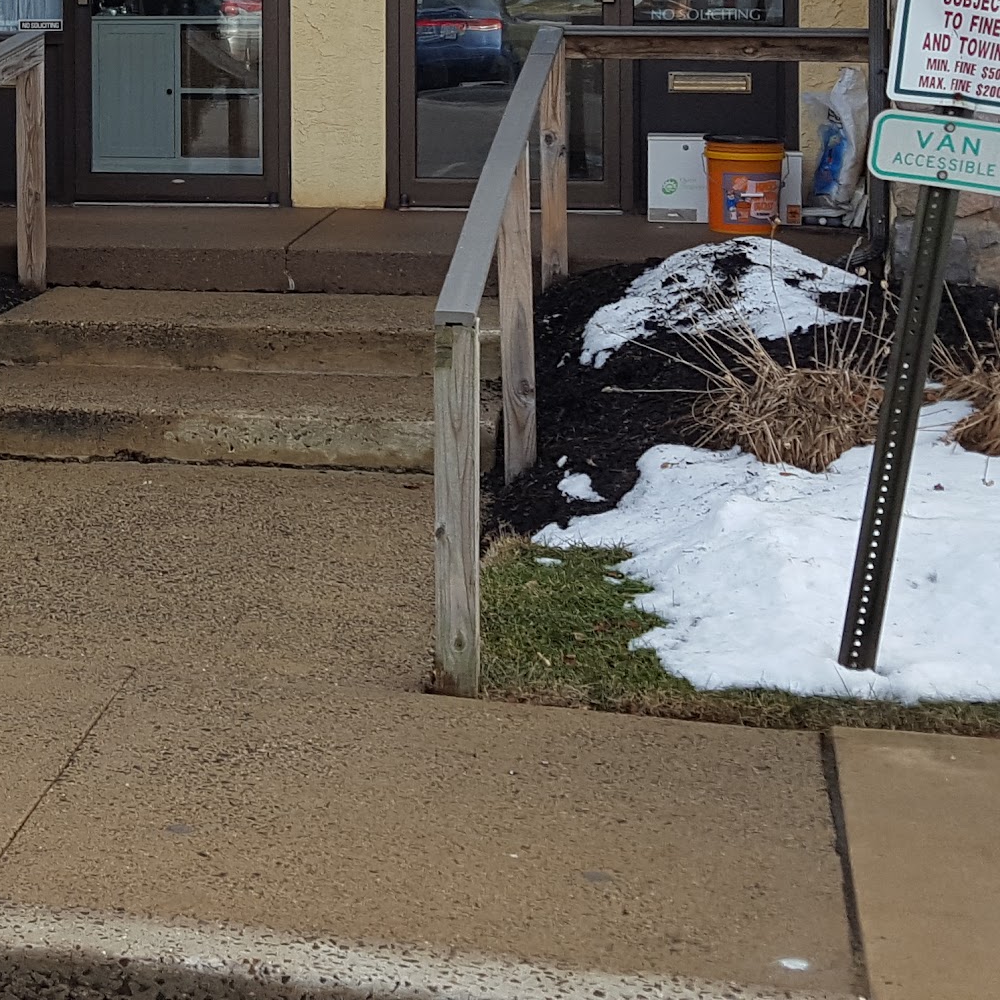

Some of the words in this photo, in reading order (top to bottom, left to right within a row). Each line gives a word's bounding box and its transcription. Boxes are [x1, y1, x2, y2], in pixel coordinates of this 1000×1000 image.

[651, 9, 675, 20] NO
[678, 8, 761, 20] SOLICITING
[944, 11, 963, 30] TO
[922, 32, 951, 52] AND
[926, 58, 950, 73] MIN.
[954, 60, 977, 76] FINE
[919, 75, 946, 90] MAX.
[950, 78, 972, 93] FINE
[917, 130, 981, 156] VAN
[892, 151, 996, 176] ACCESSIBLE
